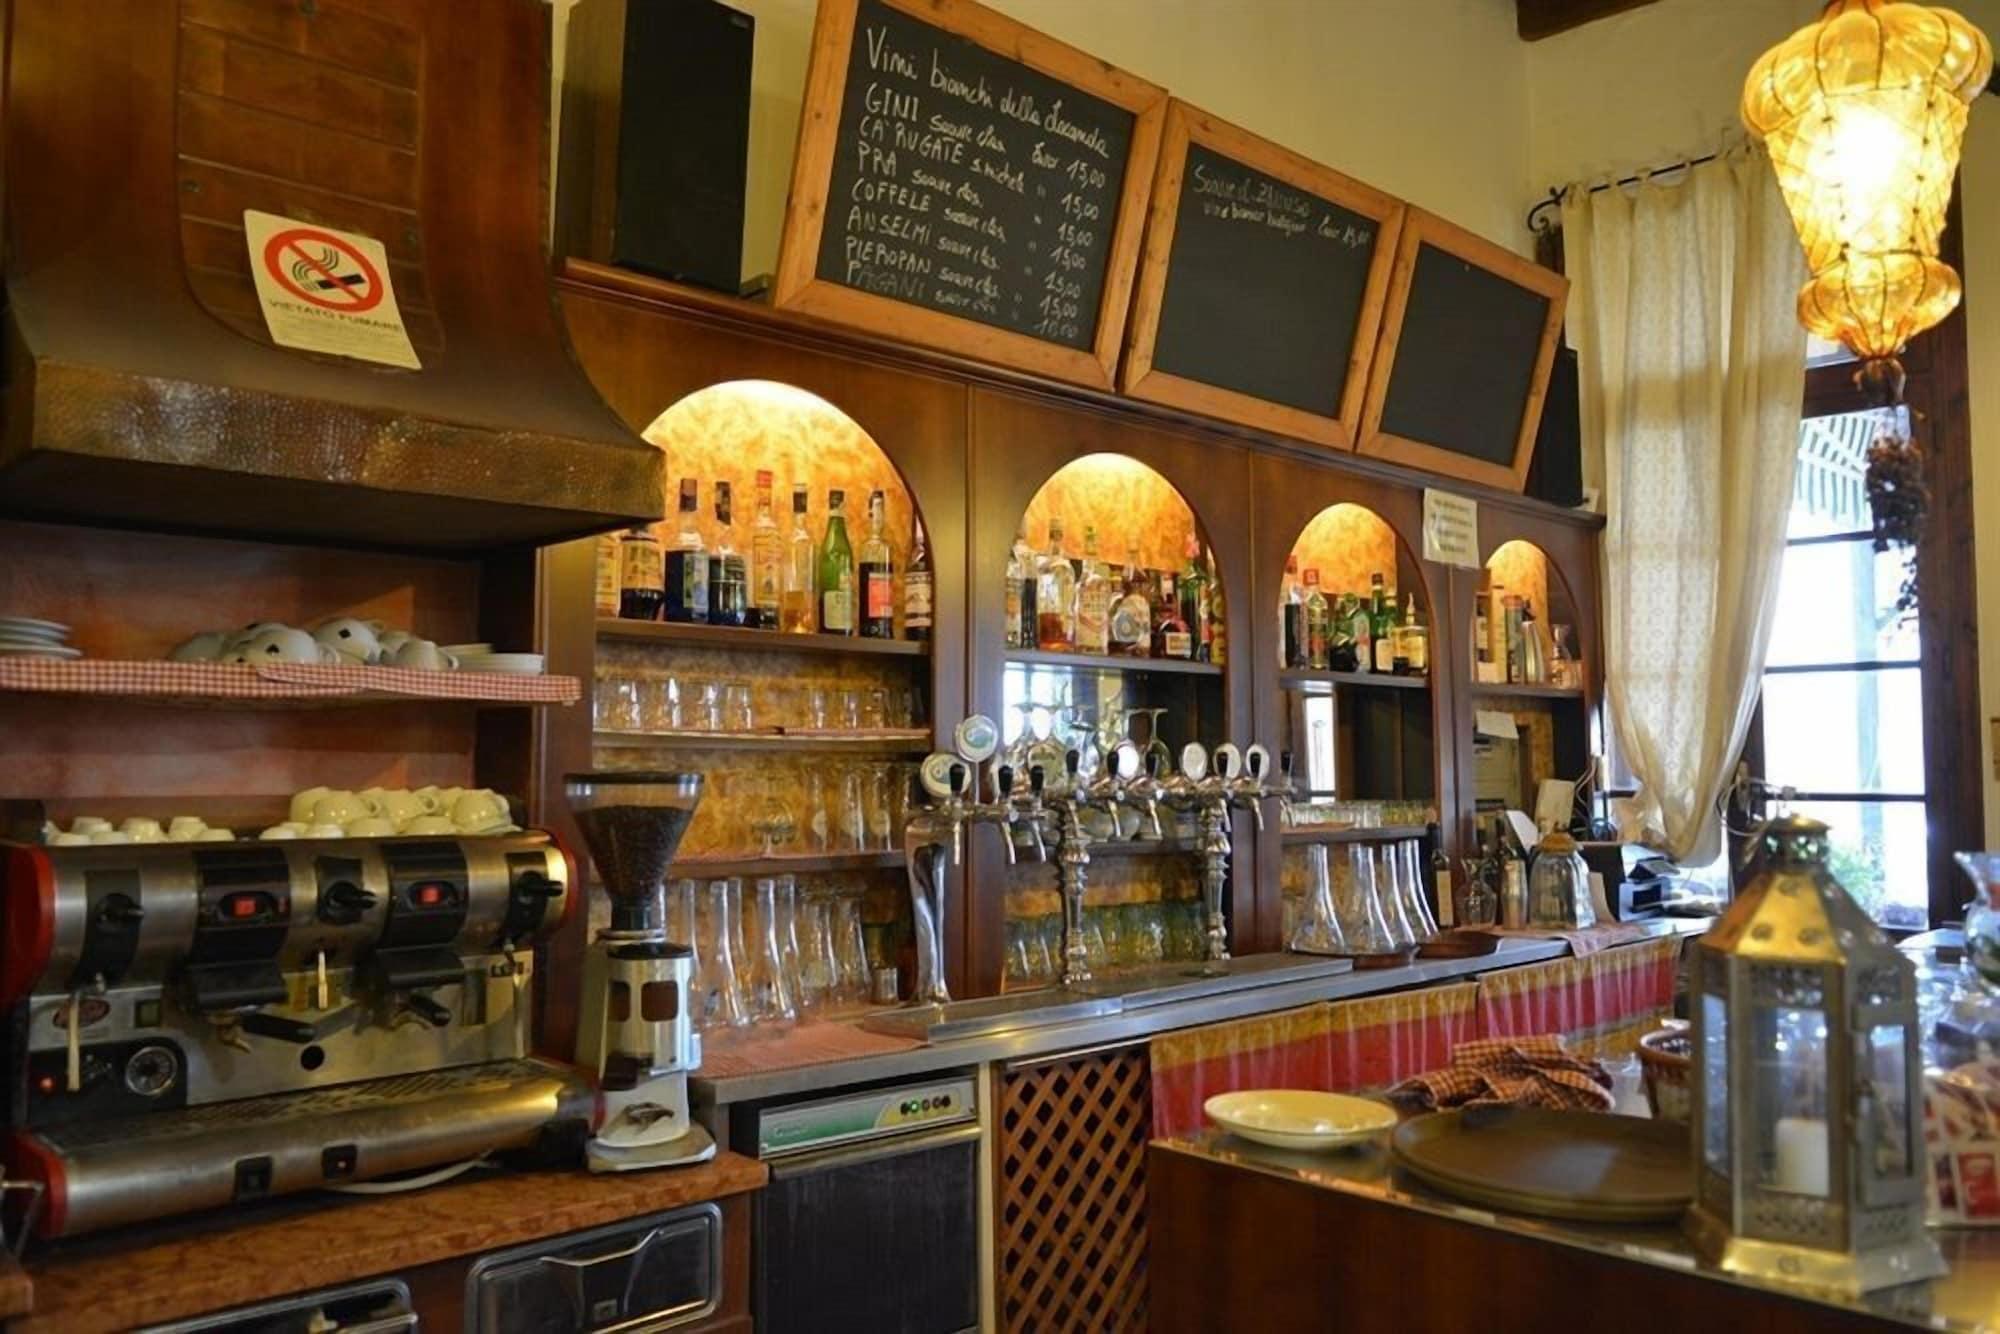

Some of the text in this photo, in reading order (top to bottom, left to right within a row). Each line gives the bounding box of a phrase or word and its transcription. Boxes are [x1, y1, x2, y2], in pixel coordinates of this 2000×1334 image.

[867, 26, 918, 80] Vini
[930, 48, 993, 108] bianchi
[865, 82, 919, 121] GINI
[1066, 160, 1106, 189] 15,00
[895, 121, 964, 164] RUGATE
[1061, 193, 1100, 220] 15,00
[852, 177, 932, 212] COFFELE
[847, 205, 932, 246] ANSELMI
[1057, 222, 1093, 247] 15,00
[845, 235, 932, 273] PIEROPAN
